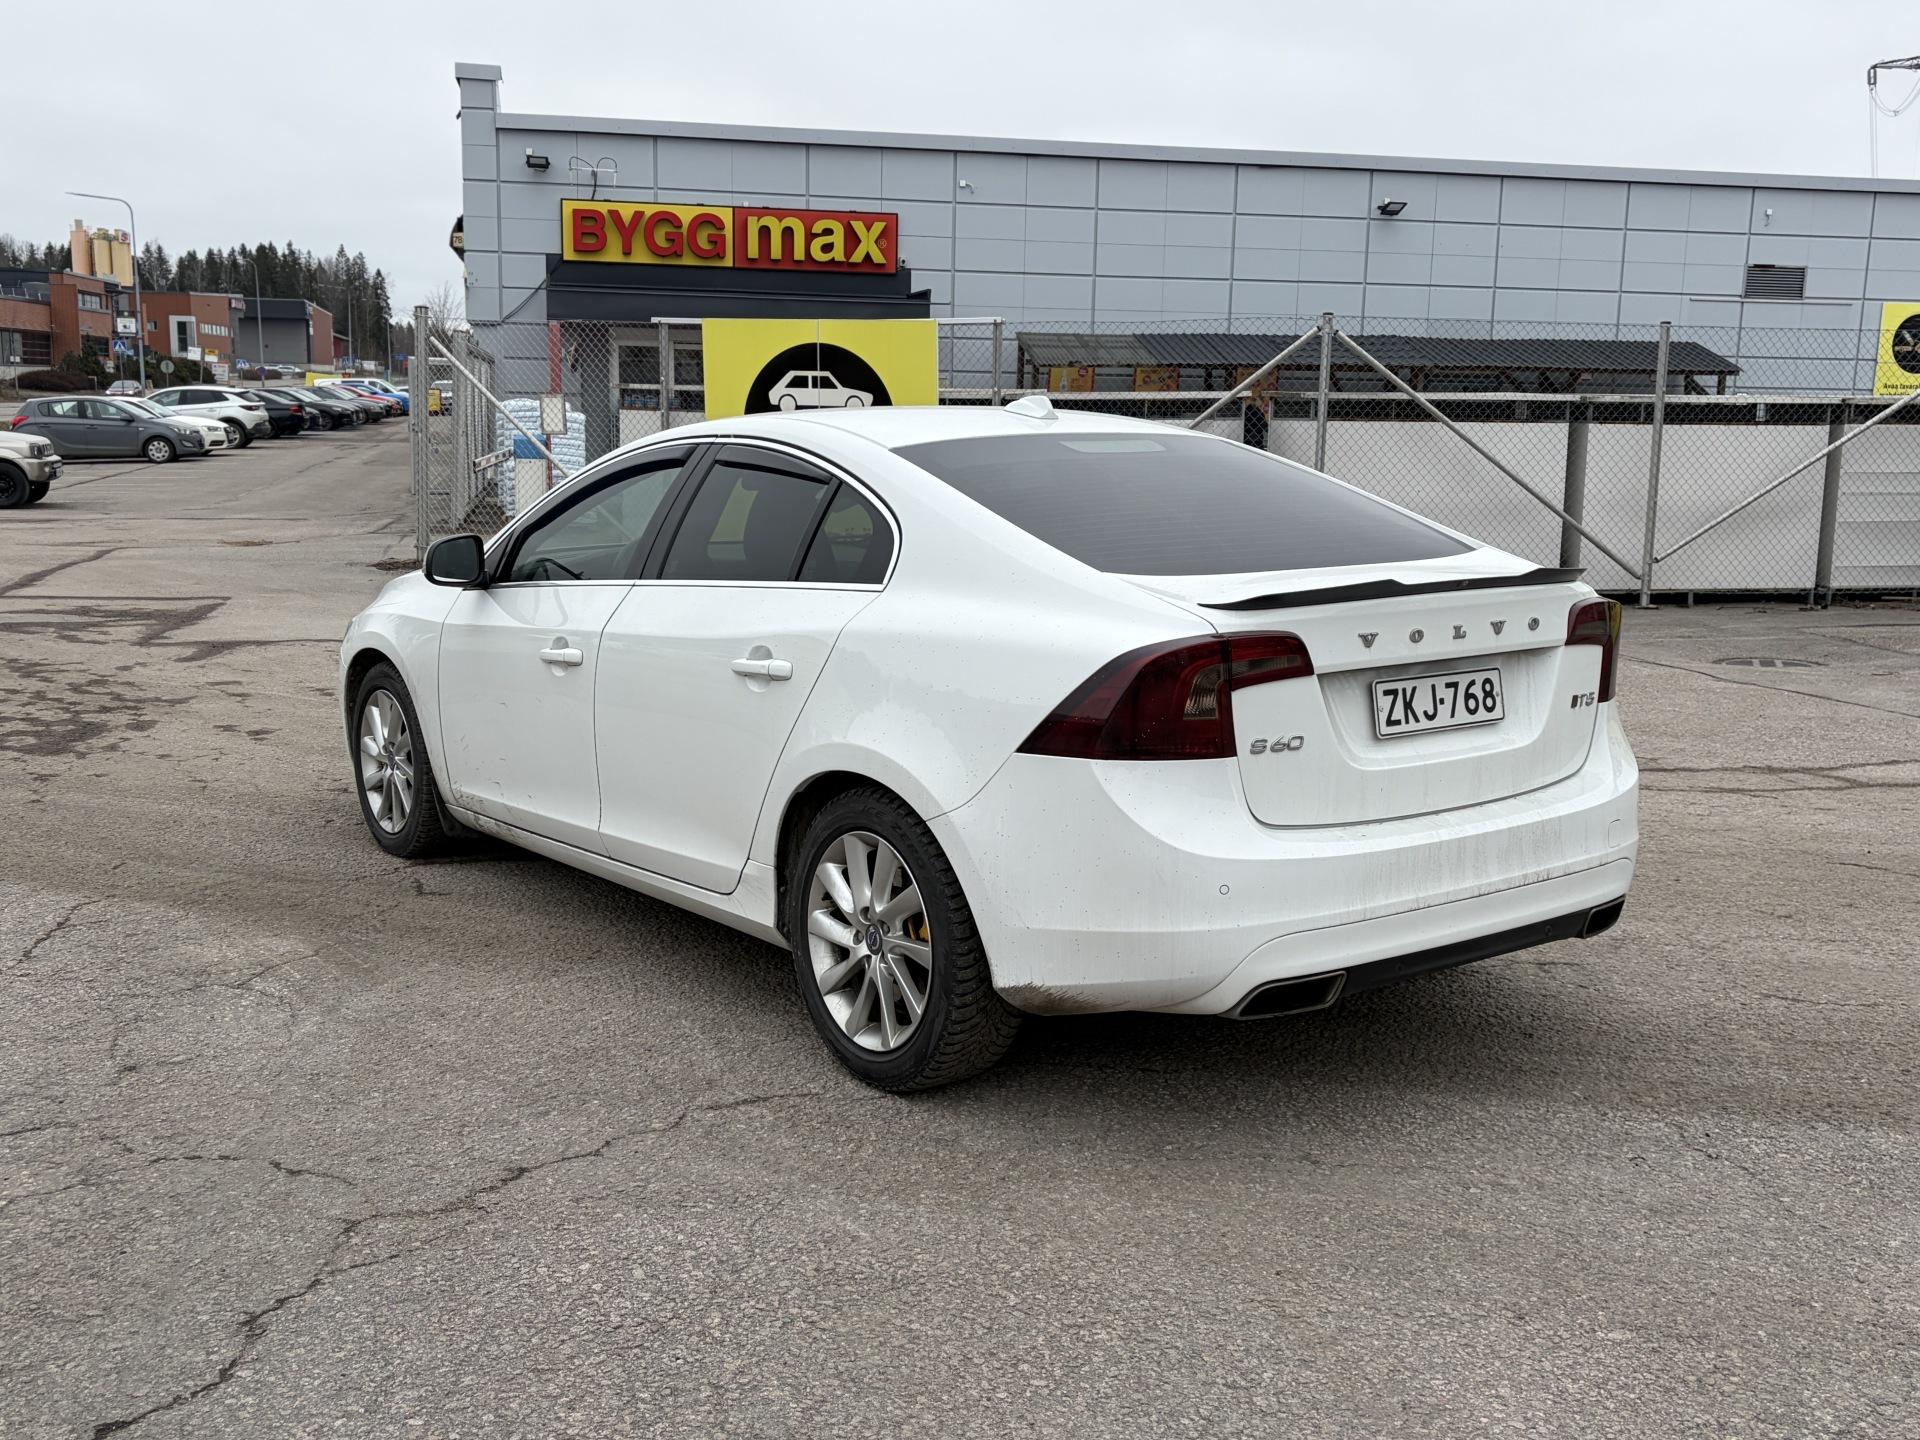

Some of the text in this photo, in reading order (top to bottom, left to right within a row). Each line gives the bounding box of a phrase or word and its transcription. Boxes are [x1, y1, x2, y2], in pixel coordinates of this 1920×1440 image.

[572, 208, 888, 264] BYGG max
[1359, 616, 1540, 648] VOLVO
[1382, 677, 1497, 727] ZKJ-768
[1249, 735, 1305, 755] S60
